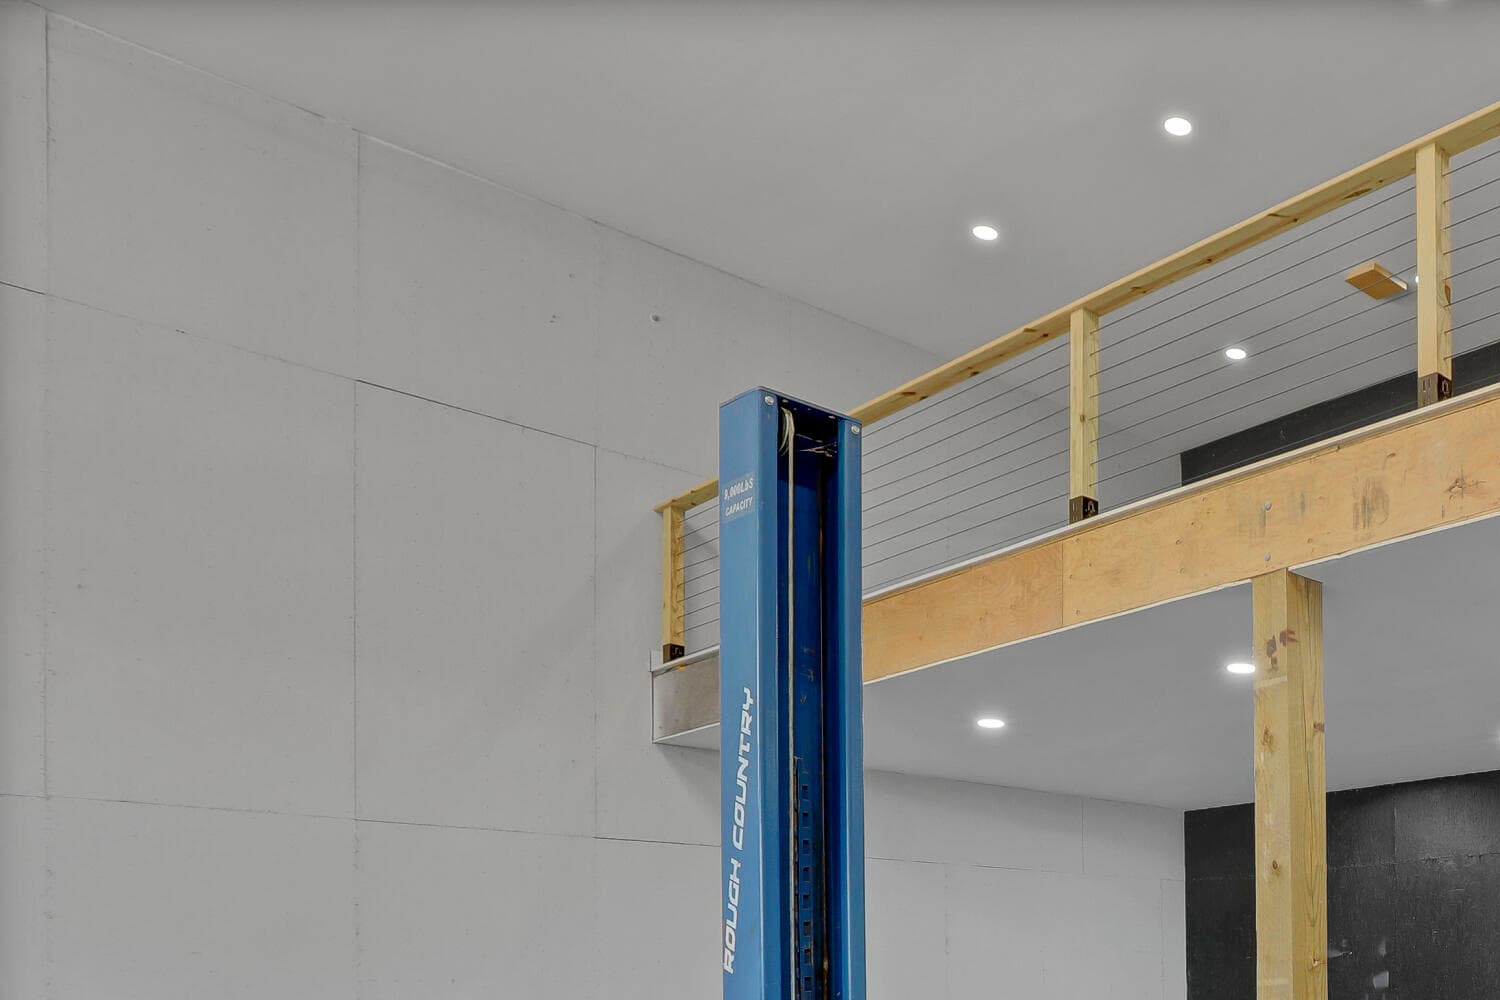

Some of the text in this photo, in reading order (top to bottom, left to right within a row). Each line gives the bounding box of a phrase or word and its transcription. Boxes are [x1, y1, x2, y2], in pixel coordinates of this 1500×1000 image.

[725, 497, 754, 517] CAPACITY
[723, 686, 755, 975] ROUGH COUNTRY
